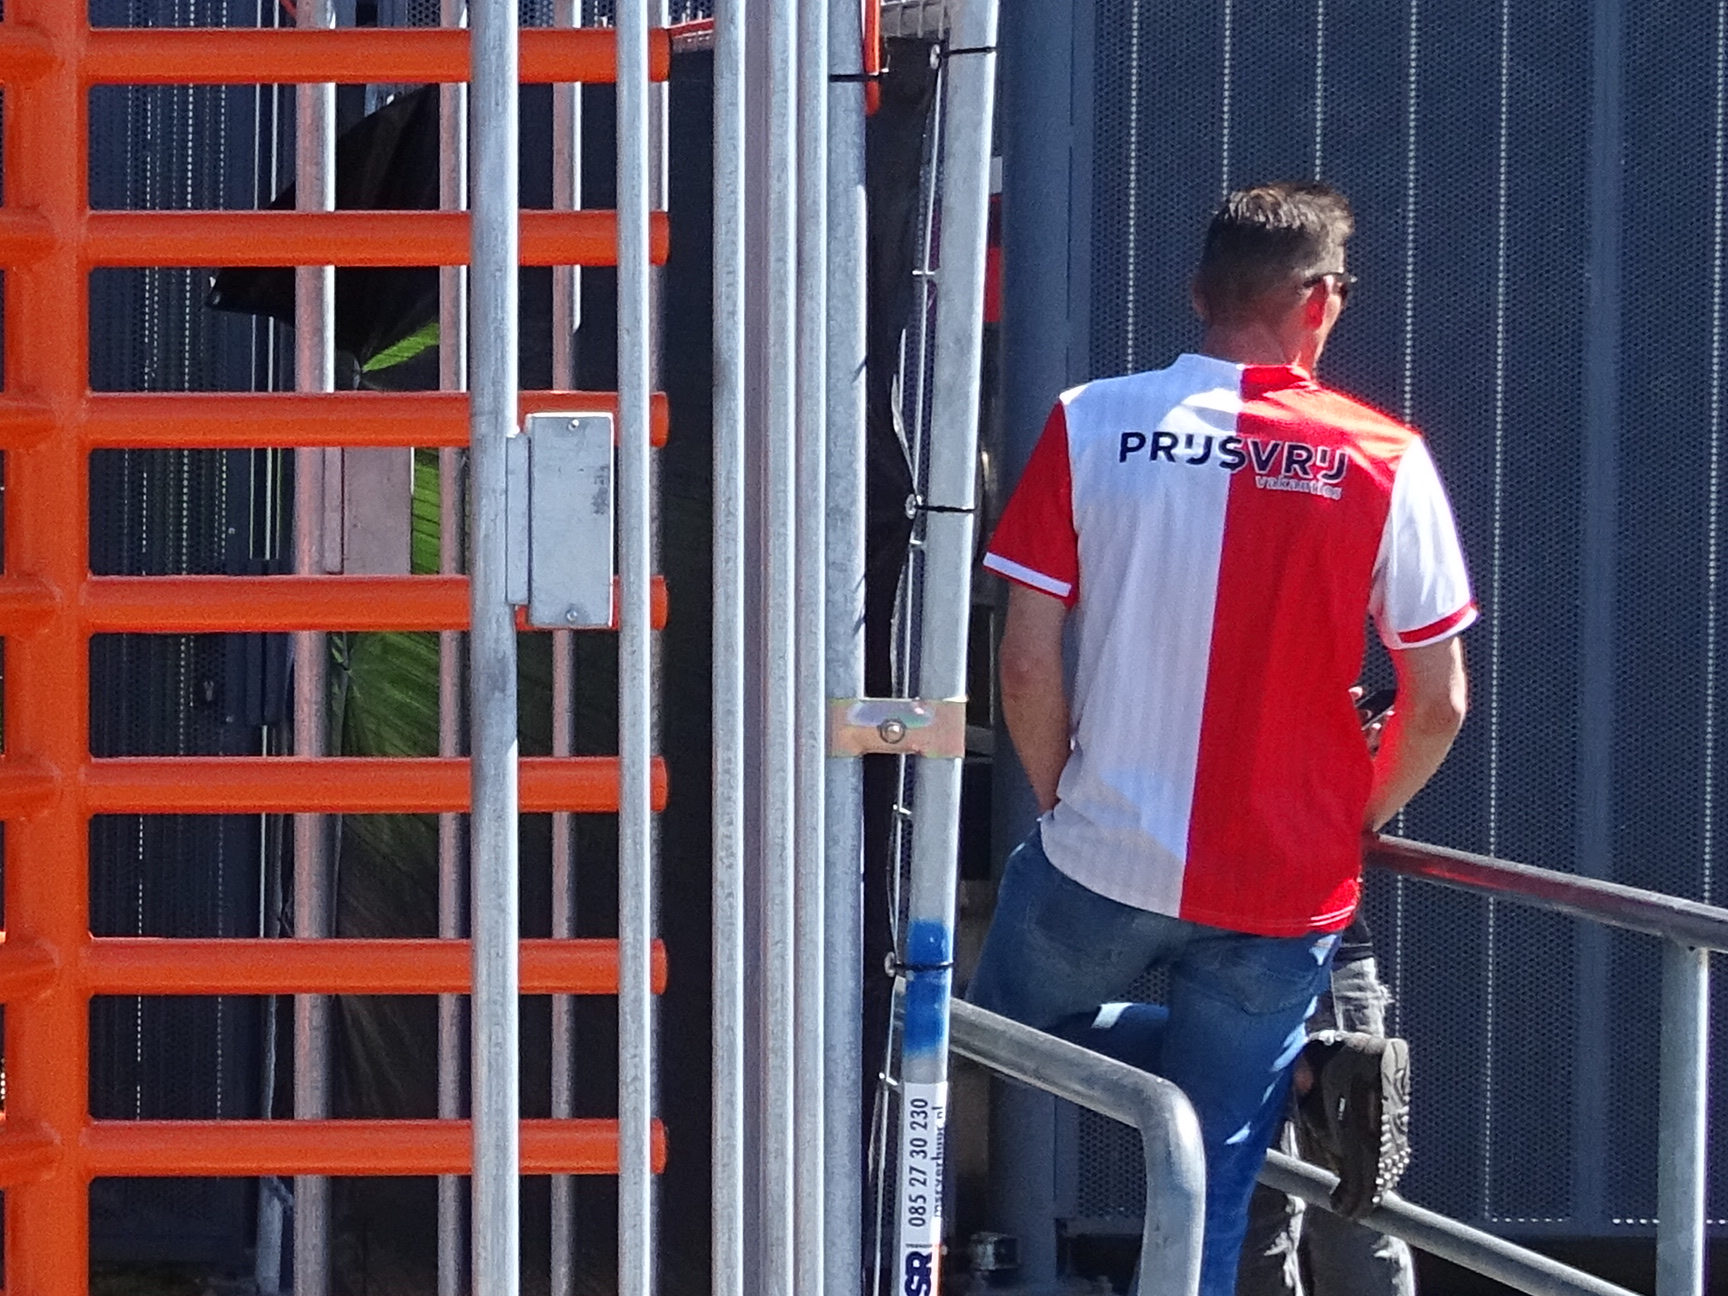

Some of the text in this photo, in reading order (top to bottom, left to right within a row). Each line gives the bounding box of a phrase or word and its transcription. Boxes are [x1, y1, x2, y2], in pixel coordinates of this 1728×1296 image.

[1118, 430, 1348, 483] PRIJSVRIJ
[910, 1098, 929, 1131] 230
[909, 1137, 928, 1160] 30
[908, 1165, 927, 1187] 27
[908, 1193, 927, 1228] 085
